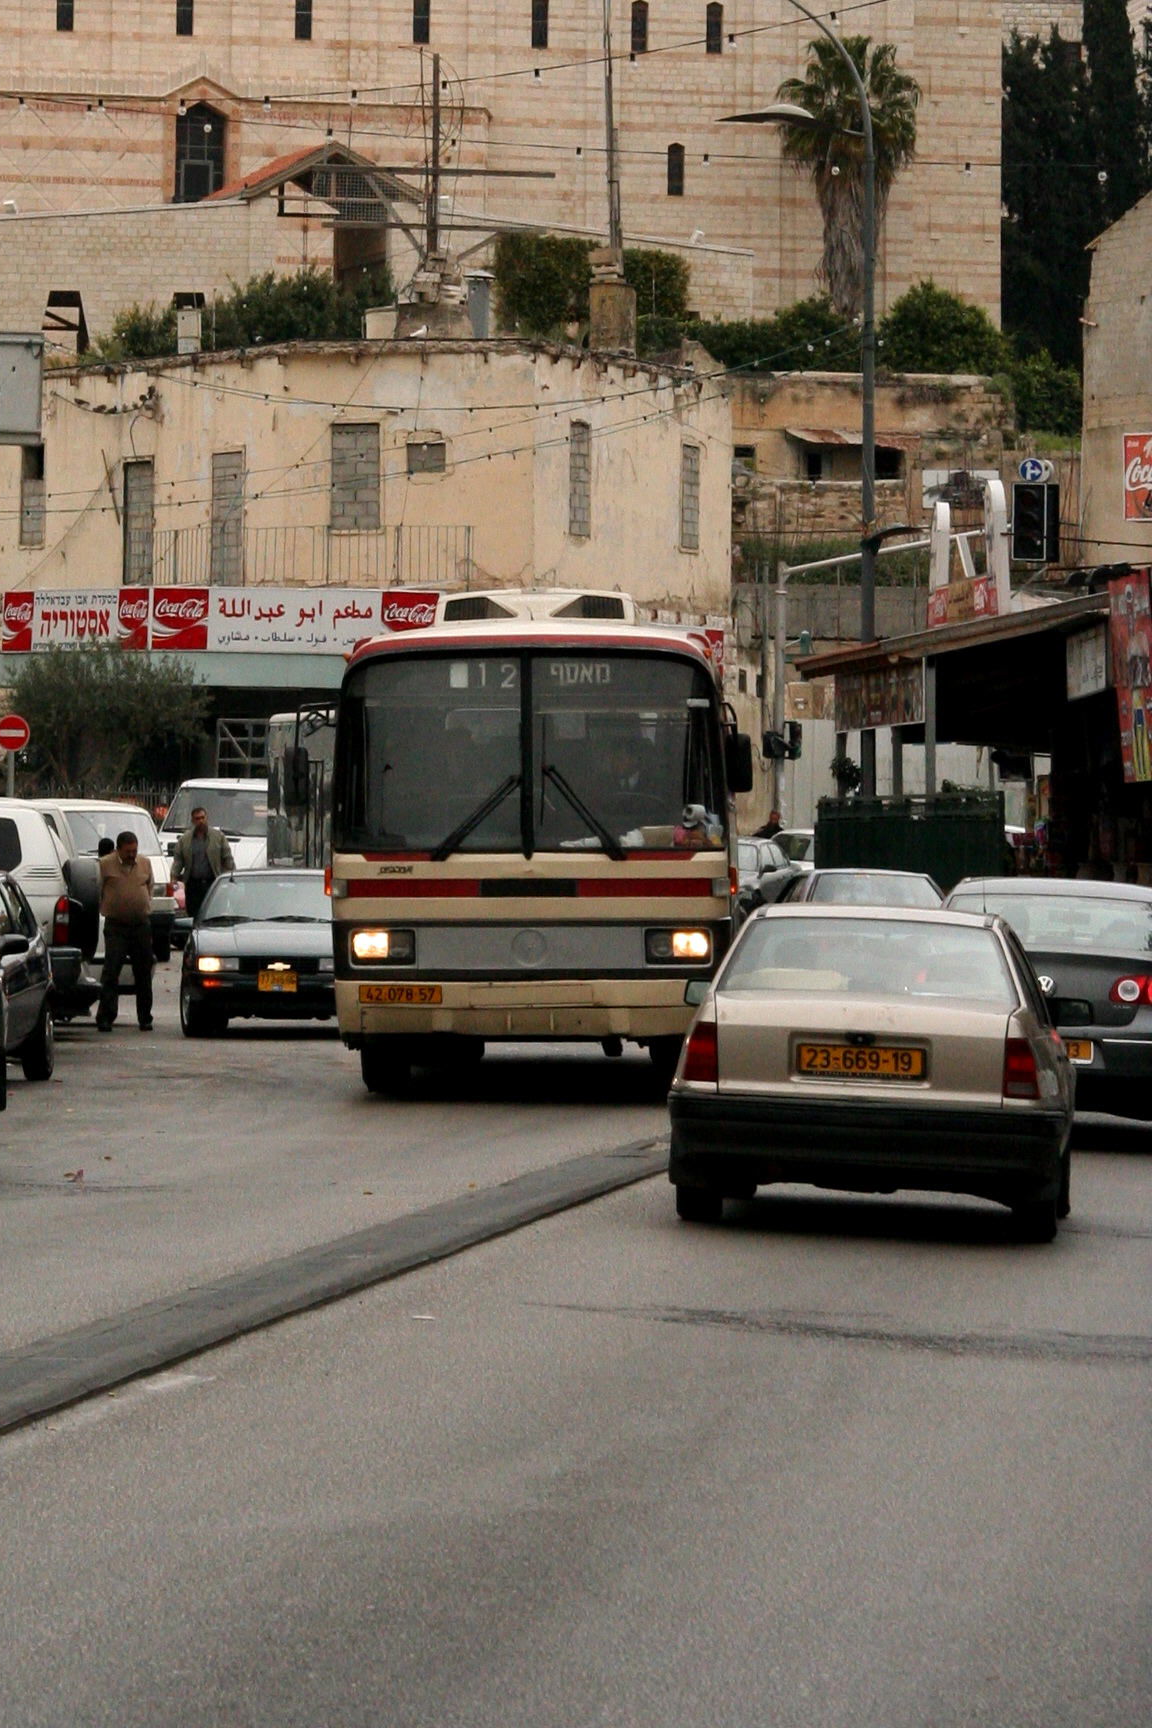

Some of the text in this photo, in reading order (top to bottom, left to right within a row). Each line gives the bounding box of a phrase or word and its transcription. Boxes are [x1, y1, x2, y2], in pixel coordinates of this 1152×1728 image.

[41, 609, 110, 638] אסטוריה
[295, 599, 322, 627] ابو
[333, 600, 373, 629] مطعم
[550, 663, 610, 686] מאסף
[806, 1048, 912, 1072] 23-669-19
